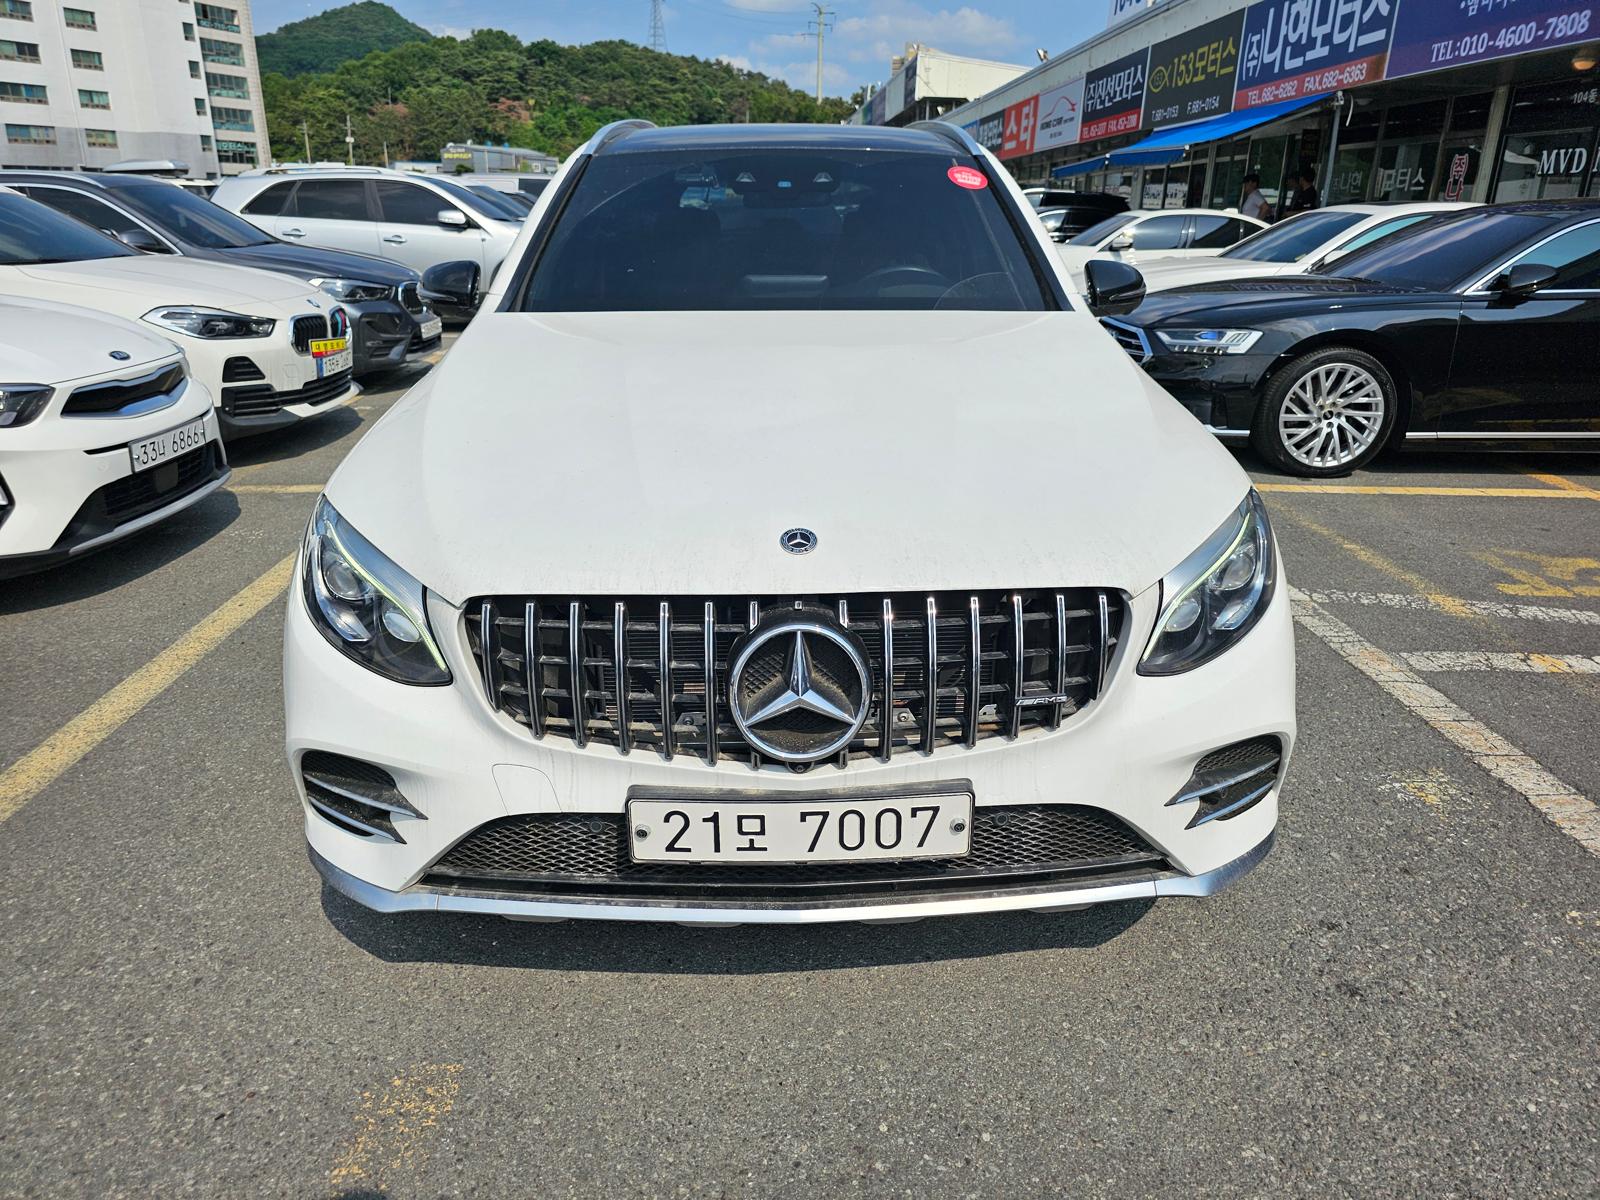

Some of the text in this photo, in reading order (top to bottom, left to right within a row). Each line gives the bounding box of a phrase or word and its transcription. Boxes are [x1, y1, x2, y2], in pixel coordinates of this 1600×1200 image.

[1430, 9, 1592, 63] TEL:010-4600-7808
[1172, 36, 1236, 89] 153모터스
[1004, 100, 1035, 151] 스타
[1538, 148, 1587, 175] MVD
[172, 425, 200, 453] 6866
[662, 805, 941, 853] 21모 7007
